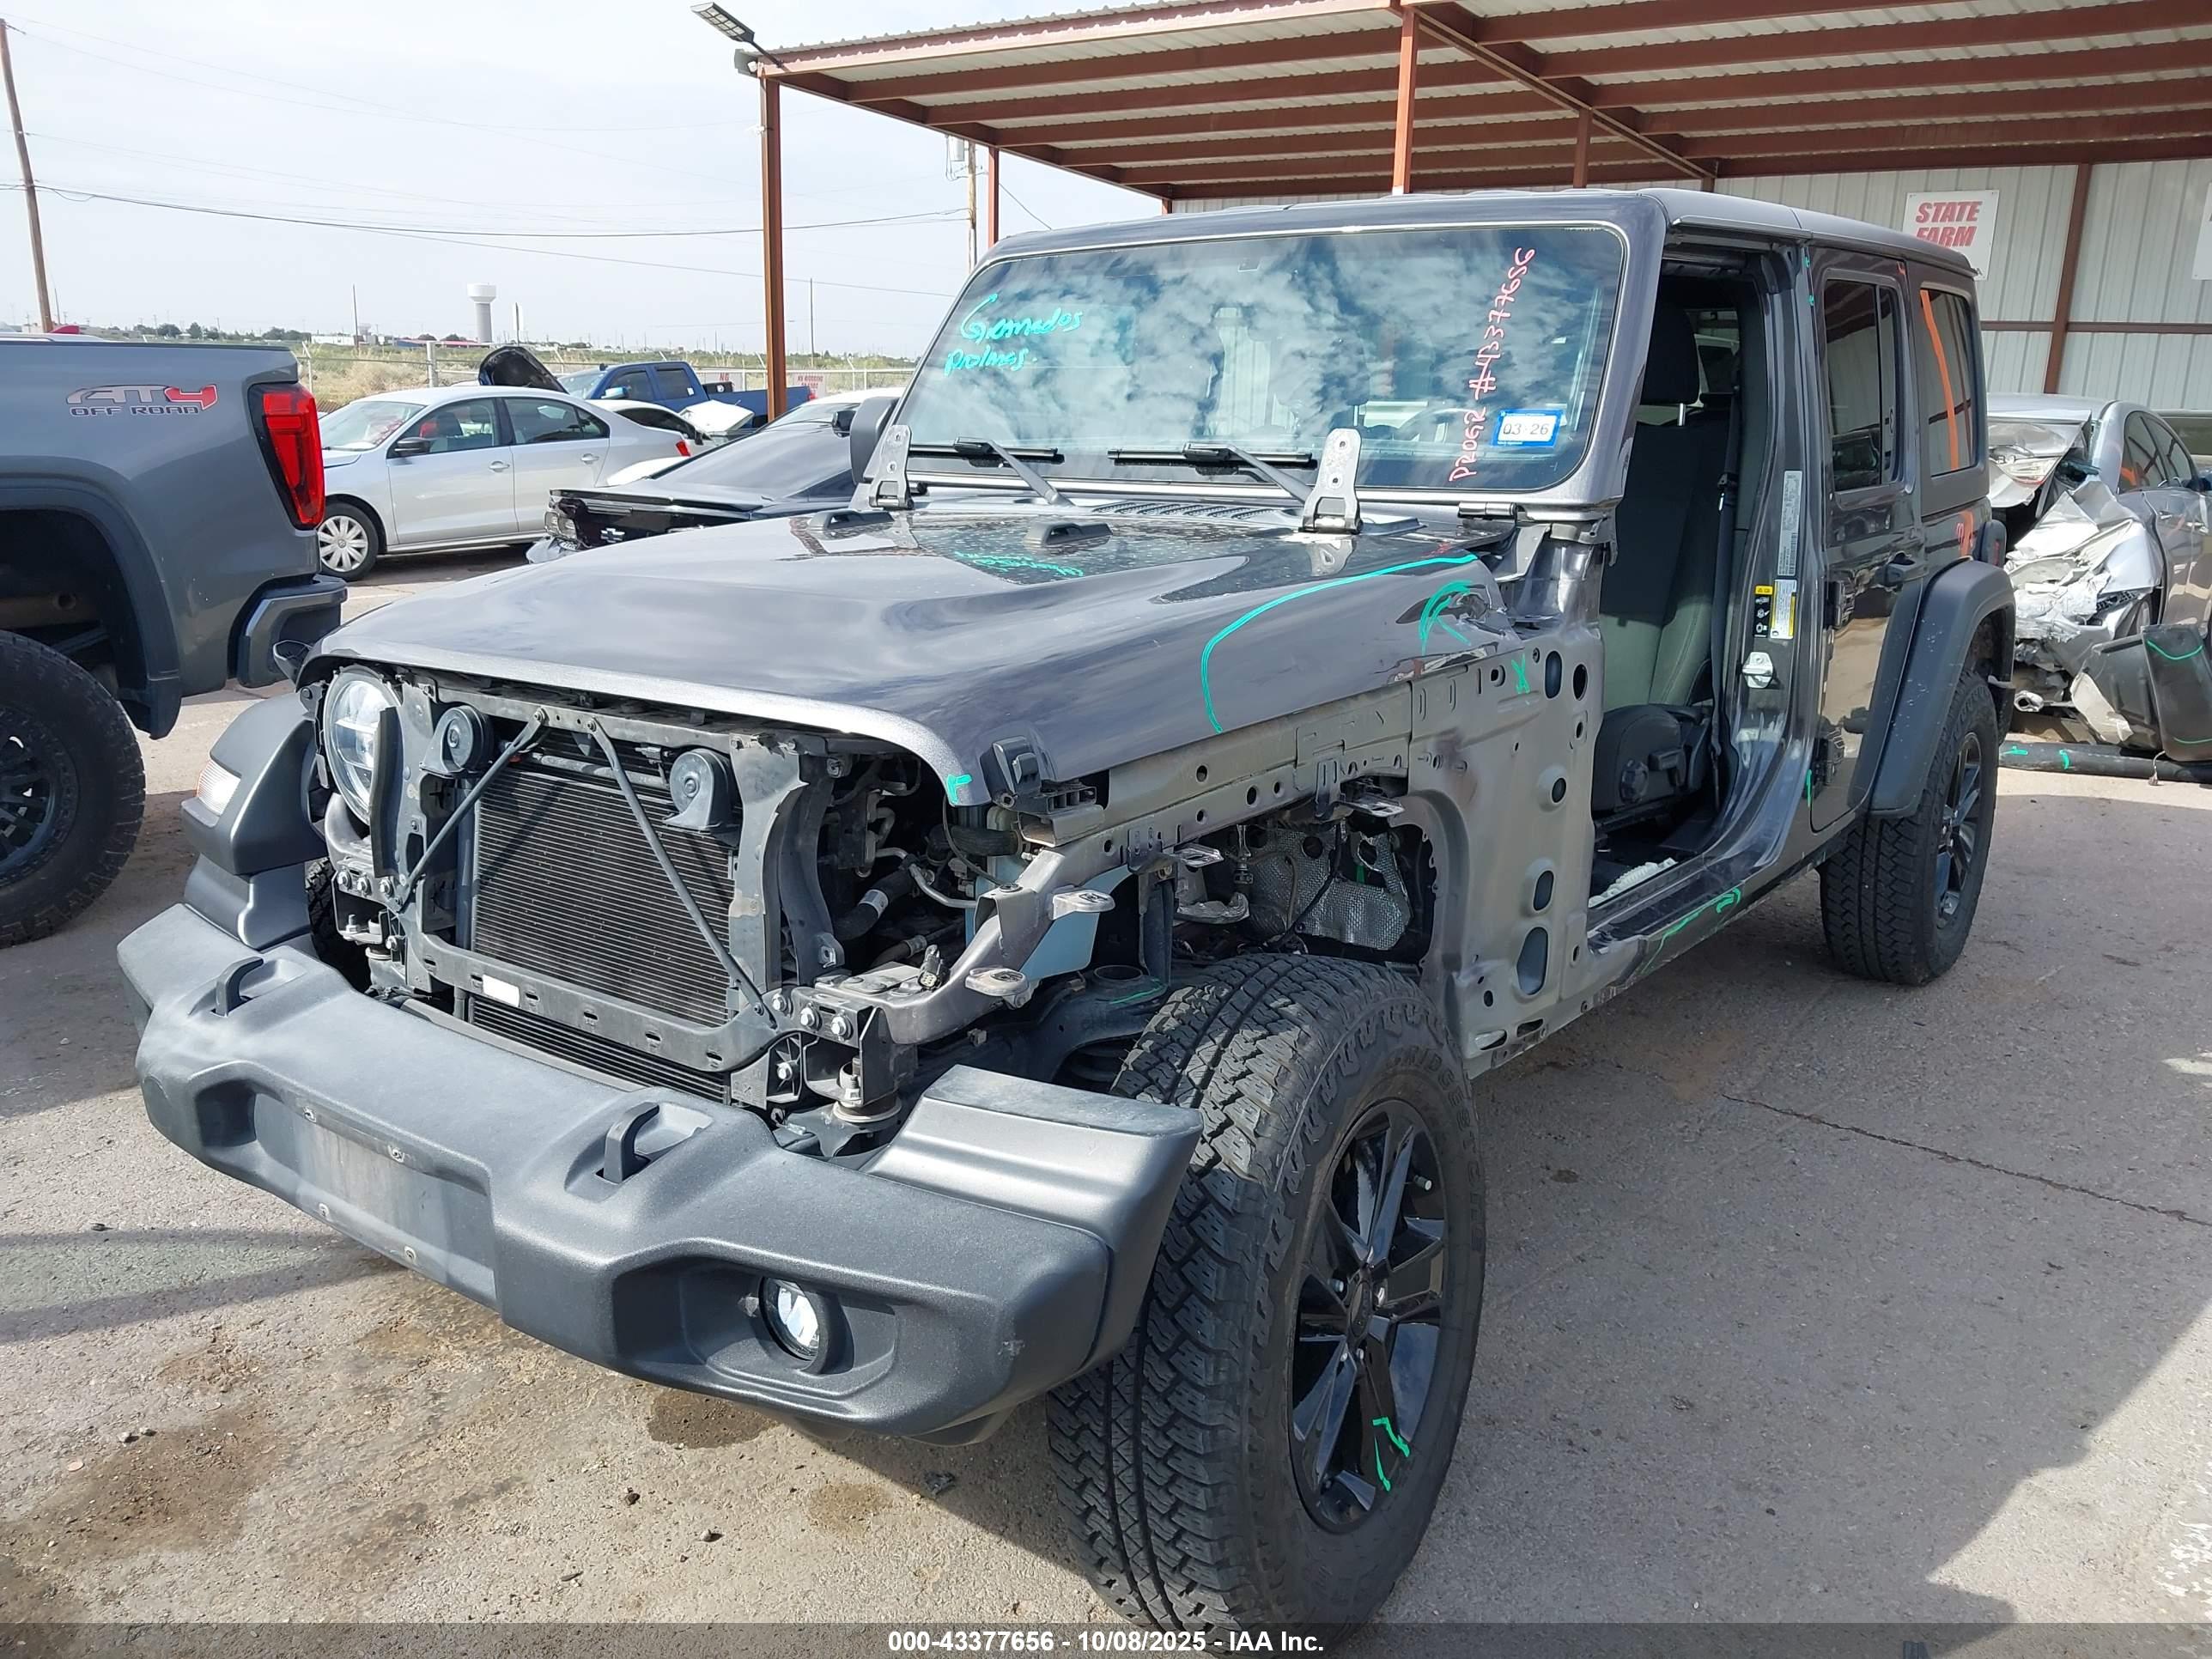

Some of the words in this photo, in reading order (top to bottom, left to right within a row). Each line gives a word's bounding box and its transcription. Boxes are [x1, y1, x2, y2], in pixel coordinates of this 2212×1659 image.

[1915, 200, 1983, 223] STATE
[1916, 225, 1977, 248] FARM
[66, 384, 218, 410] AT4
[70, 406, 122, 417] OFF
[131, 405, 199, 416] ROAD
